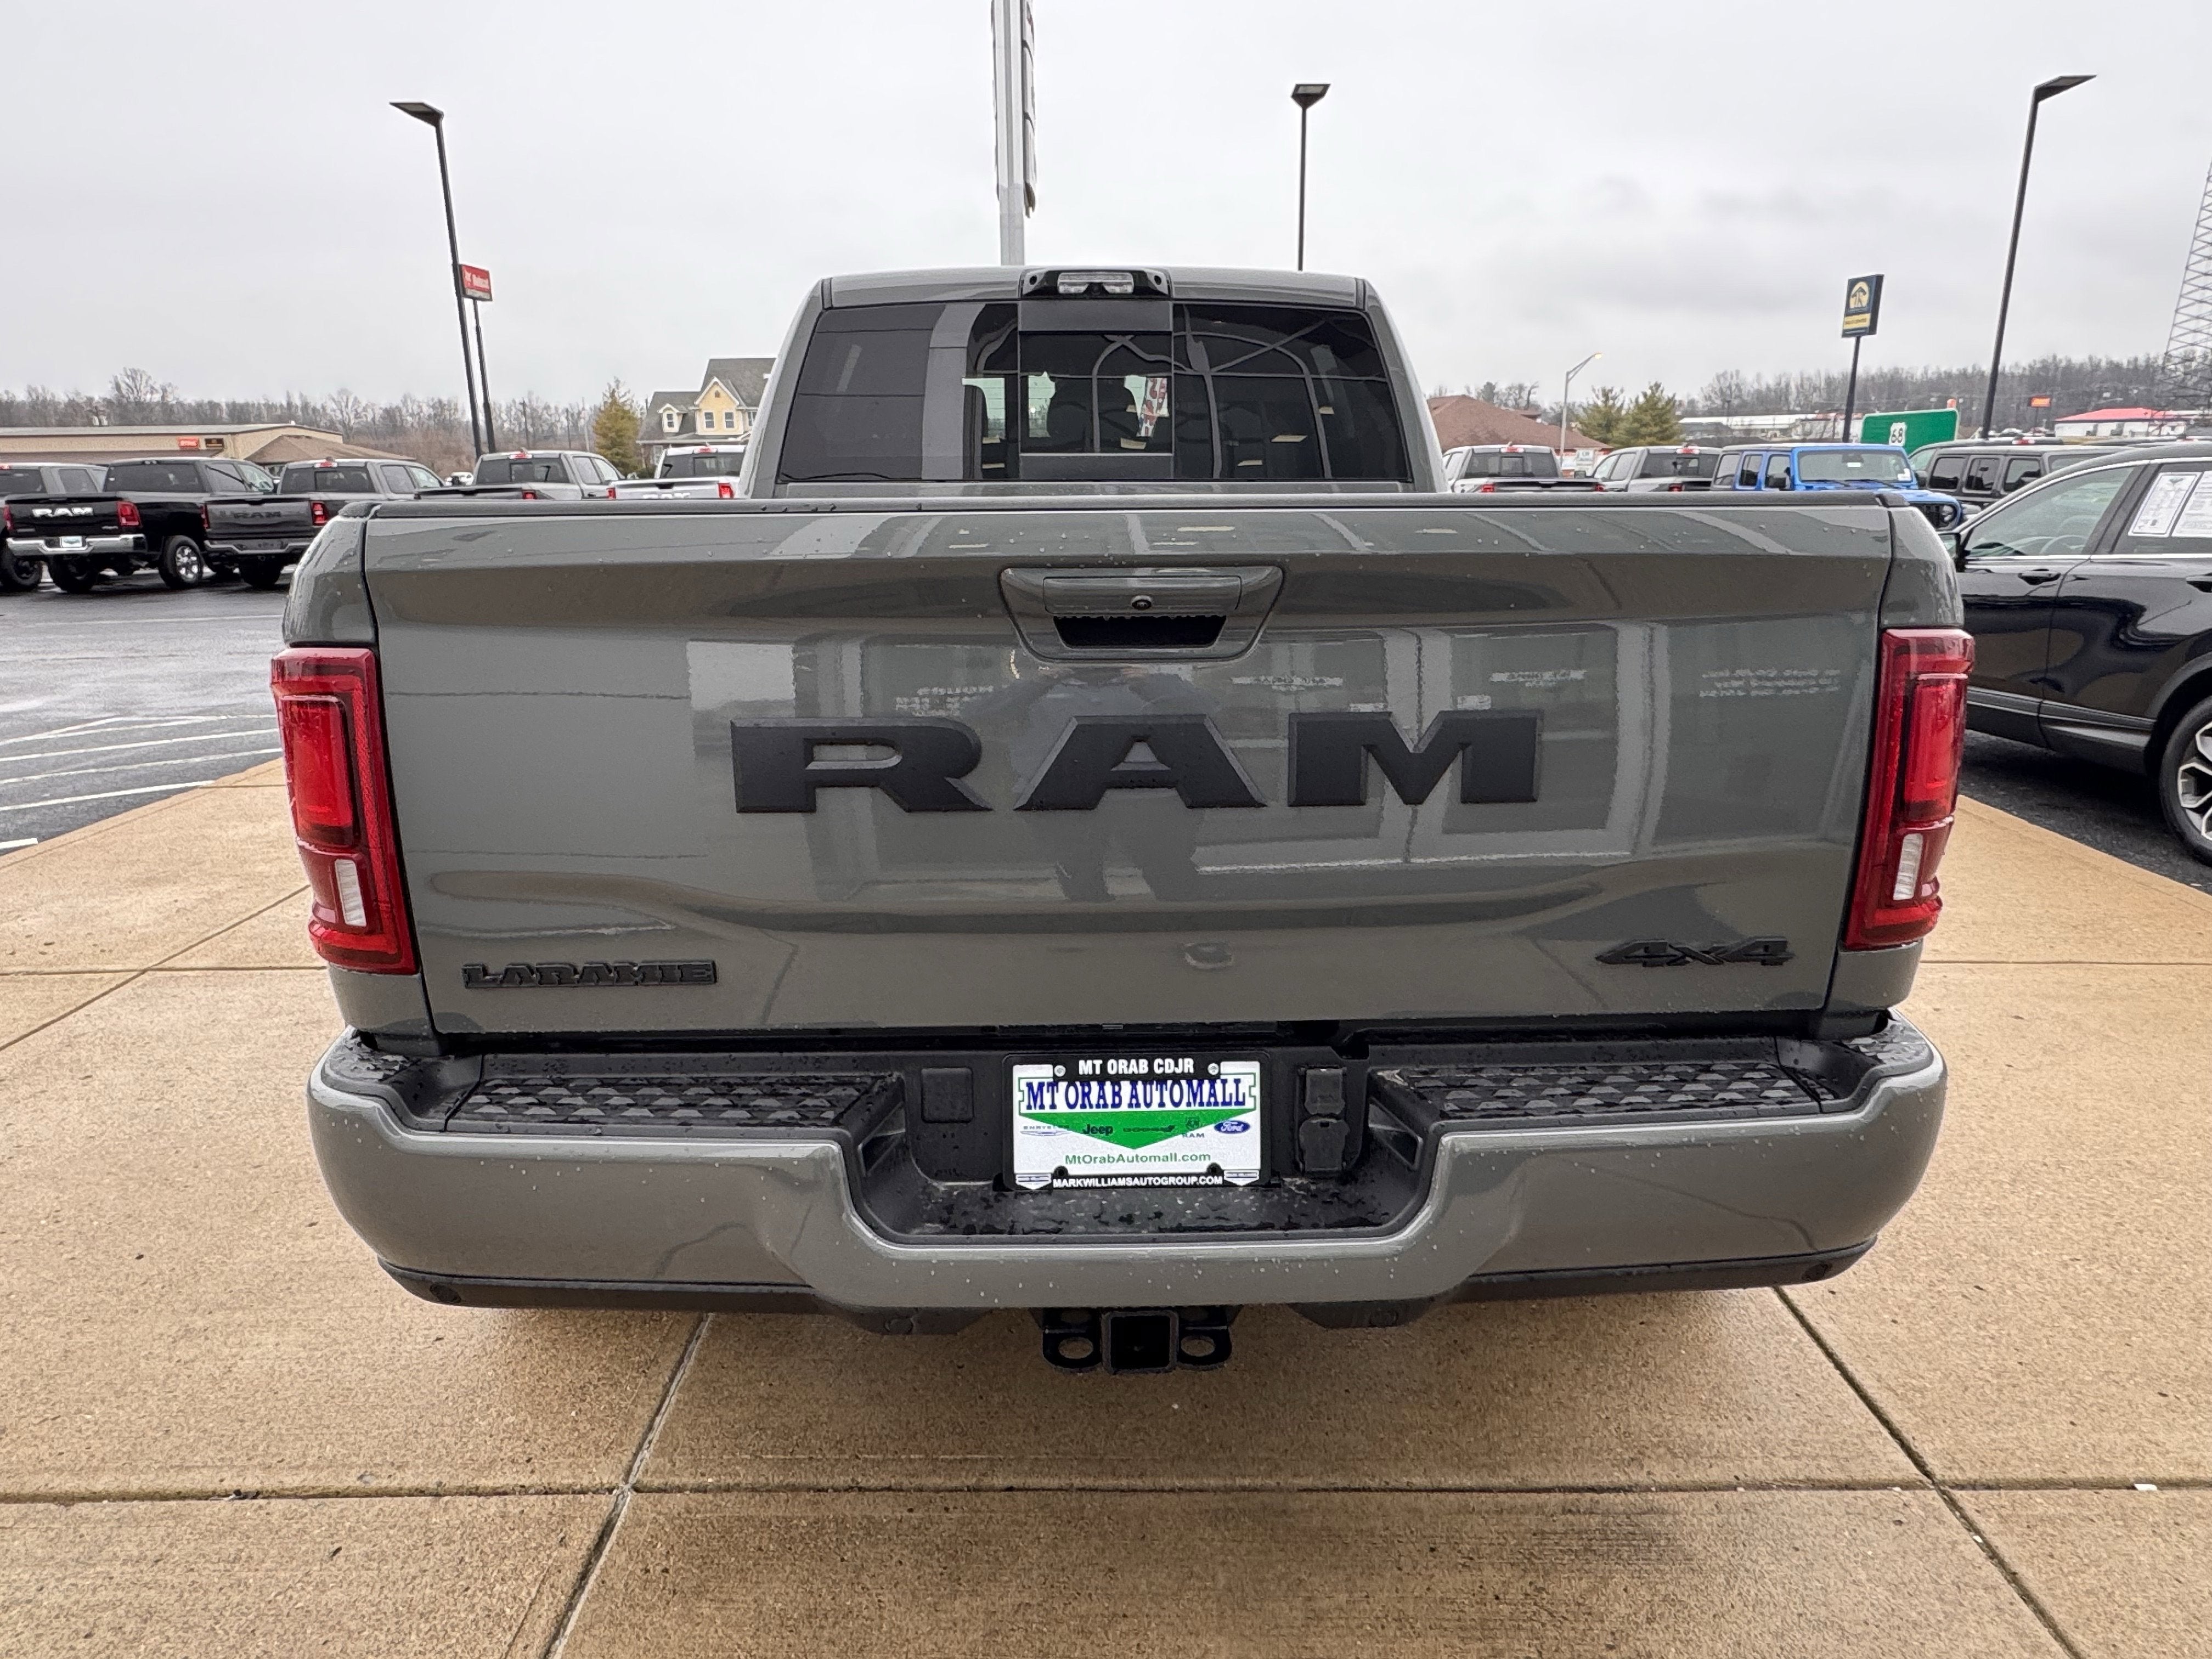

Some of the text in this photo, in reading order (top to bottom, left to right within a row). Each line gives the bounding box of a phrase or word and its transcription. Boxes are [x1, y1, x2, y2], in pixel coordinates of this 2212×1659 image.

[1891, 427, 1903, 443] 68
[32, 507, 93, 517] RAM
[731, 710, 1543, 813] RAM
[462, 960, 717, 988] LARAMIE
[1079, 1058, 1194, 1075] MT ORAB CDJR
[1026, 1078, 1245, 1110] MT ORAB AUTOMALL
[1082, 1124, 1113, 1136] Jeep
[1220, 1121, 1244, 1131] Ford
[1065, 1153, 1211, 1164] MtOrabAutomall.com
[1053, 1176, 1223, 1188] MARKWILLIAMSAUTOGROUP.COM
